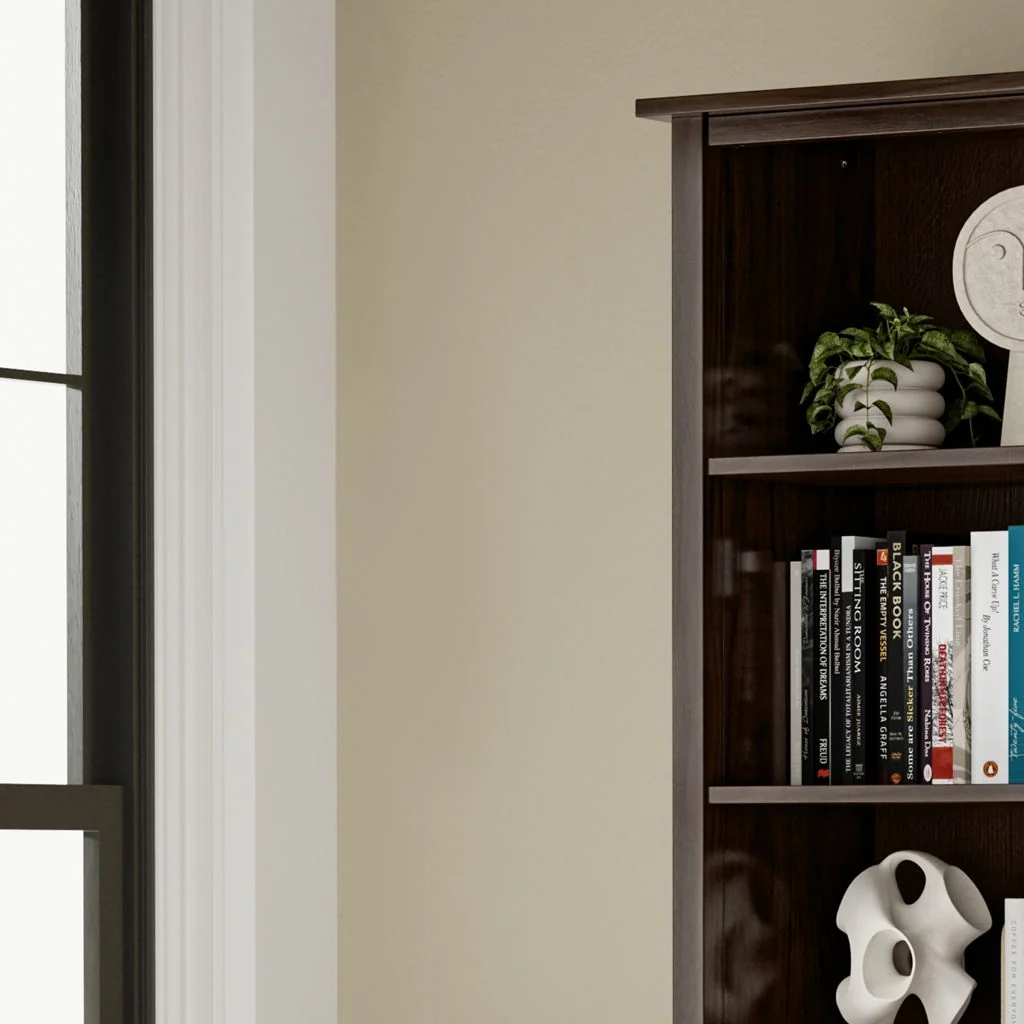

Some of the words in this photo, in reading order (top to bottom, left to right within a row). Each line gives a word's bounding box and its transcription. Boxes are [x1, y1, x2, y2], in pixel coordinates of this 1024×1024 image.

[880, 552, 887, 562] 4
[892, 542, 902, 592] BLACK
[991, 552, 1000, 570] What
[819, 573, 828, 589] THE
[880, 577, 888, 594] THE
[938, 568, 949, 590] JACKIE
[991, 579, 1000, 599] Carve
[832, 598, 841, 606] by
[854, 563, 862, 621] SITTING
[938, 592, 949, 609] PRICE
[833, 608, 841, 626] Nazir
[880, 597, 888, 627] EMPTY
[892, 596, 902, 640] BOOK
[982, 614, 991, 624] By
[990, 600, 1000, 614] Up!
[819, 591, 828, 654] INTERPRETATION
[906, 608, 914, 649] Others
[833, 627, 841, 651] Ahmad
[845, 643, 852, 651] IN
[854, 626, 862, 674] ROOM
[880, 629, 888, 662] VESSEL
[982, 624, 991, 657] Jonathan
[819, 656, 828, 666] OF
[906, 652, 914, 683] Than
[982, 659, 991, 672] Coe
[819, 669, 828, 700] DREAMS
[880, 675, 888, 722] ANGELLA
[906, 685, 914, 723] Sicker
[845, 718, 852, 728] OF
[819, 738, 828, 764] FREUD
[880, 726, 888, 760] GRAFF
